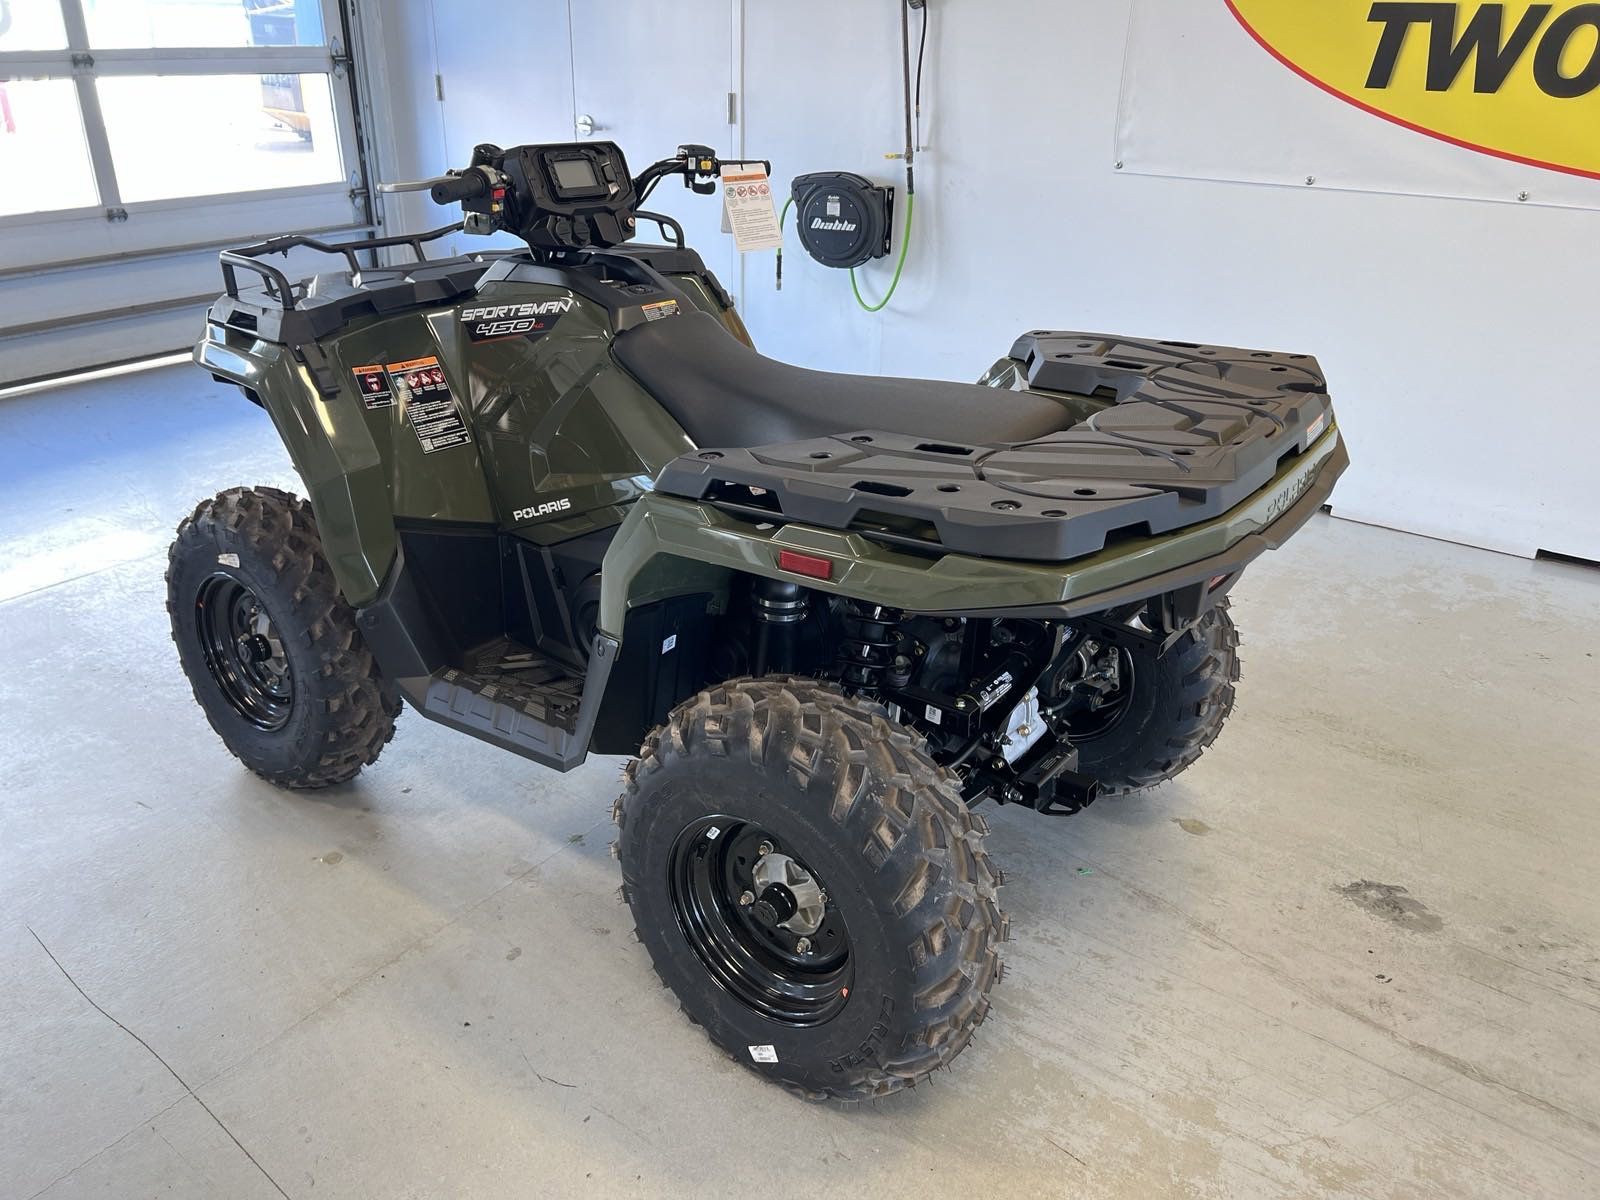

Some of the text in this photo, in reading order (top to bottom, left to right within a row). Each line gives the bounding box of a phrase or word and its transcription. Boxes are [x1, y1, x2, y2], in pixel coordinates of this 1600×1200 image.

[1364, 2, 1600, 98] TWO
[810, 217, 857, 232] Diablo
[460, 298, 573, 322] SPORTSMAN
[476, 318, 536, 336] 450
[513, 498, 571, 521] POLARIS
